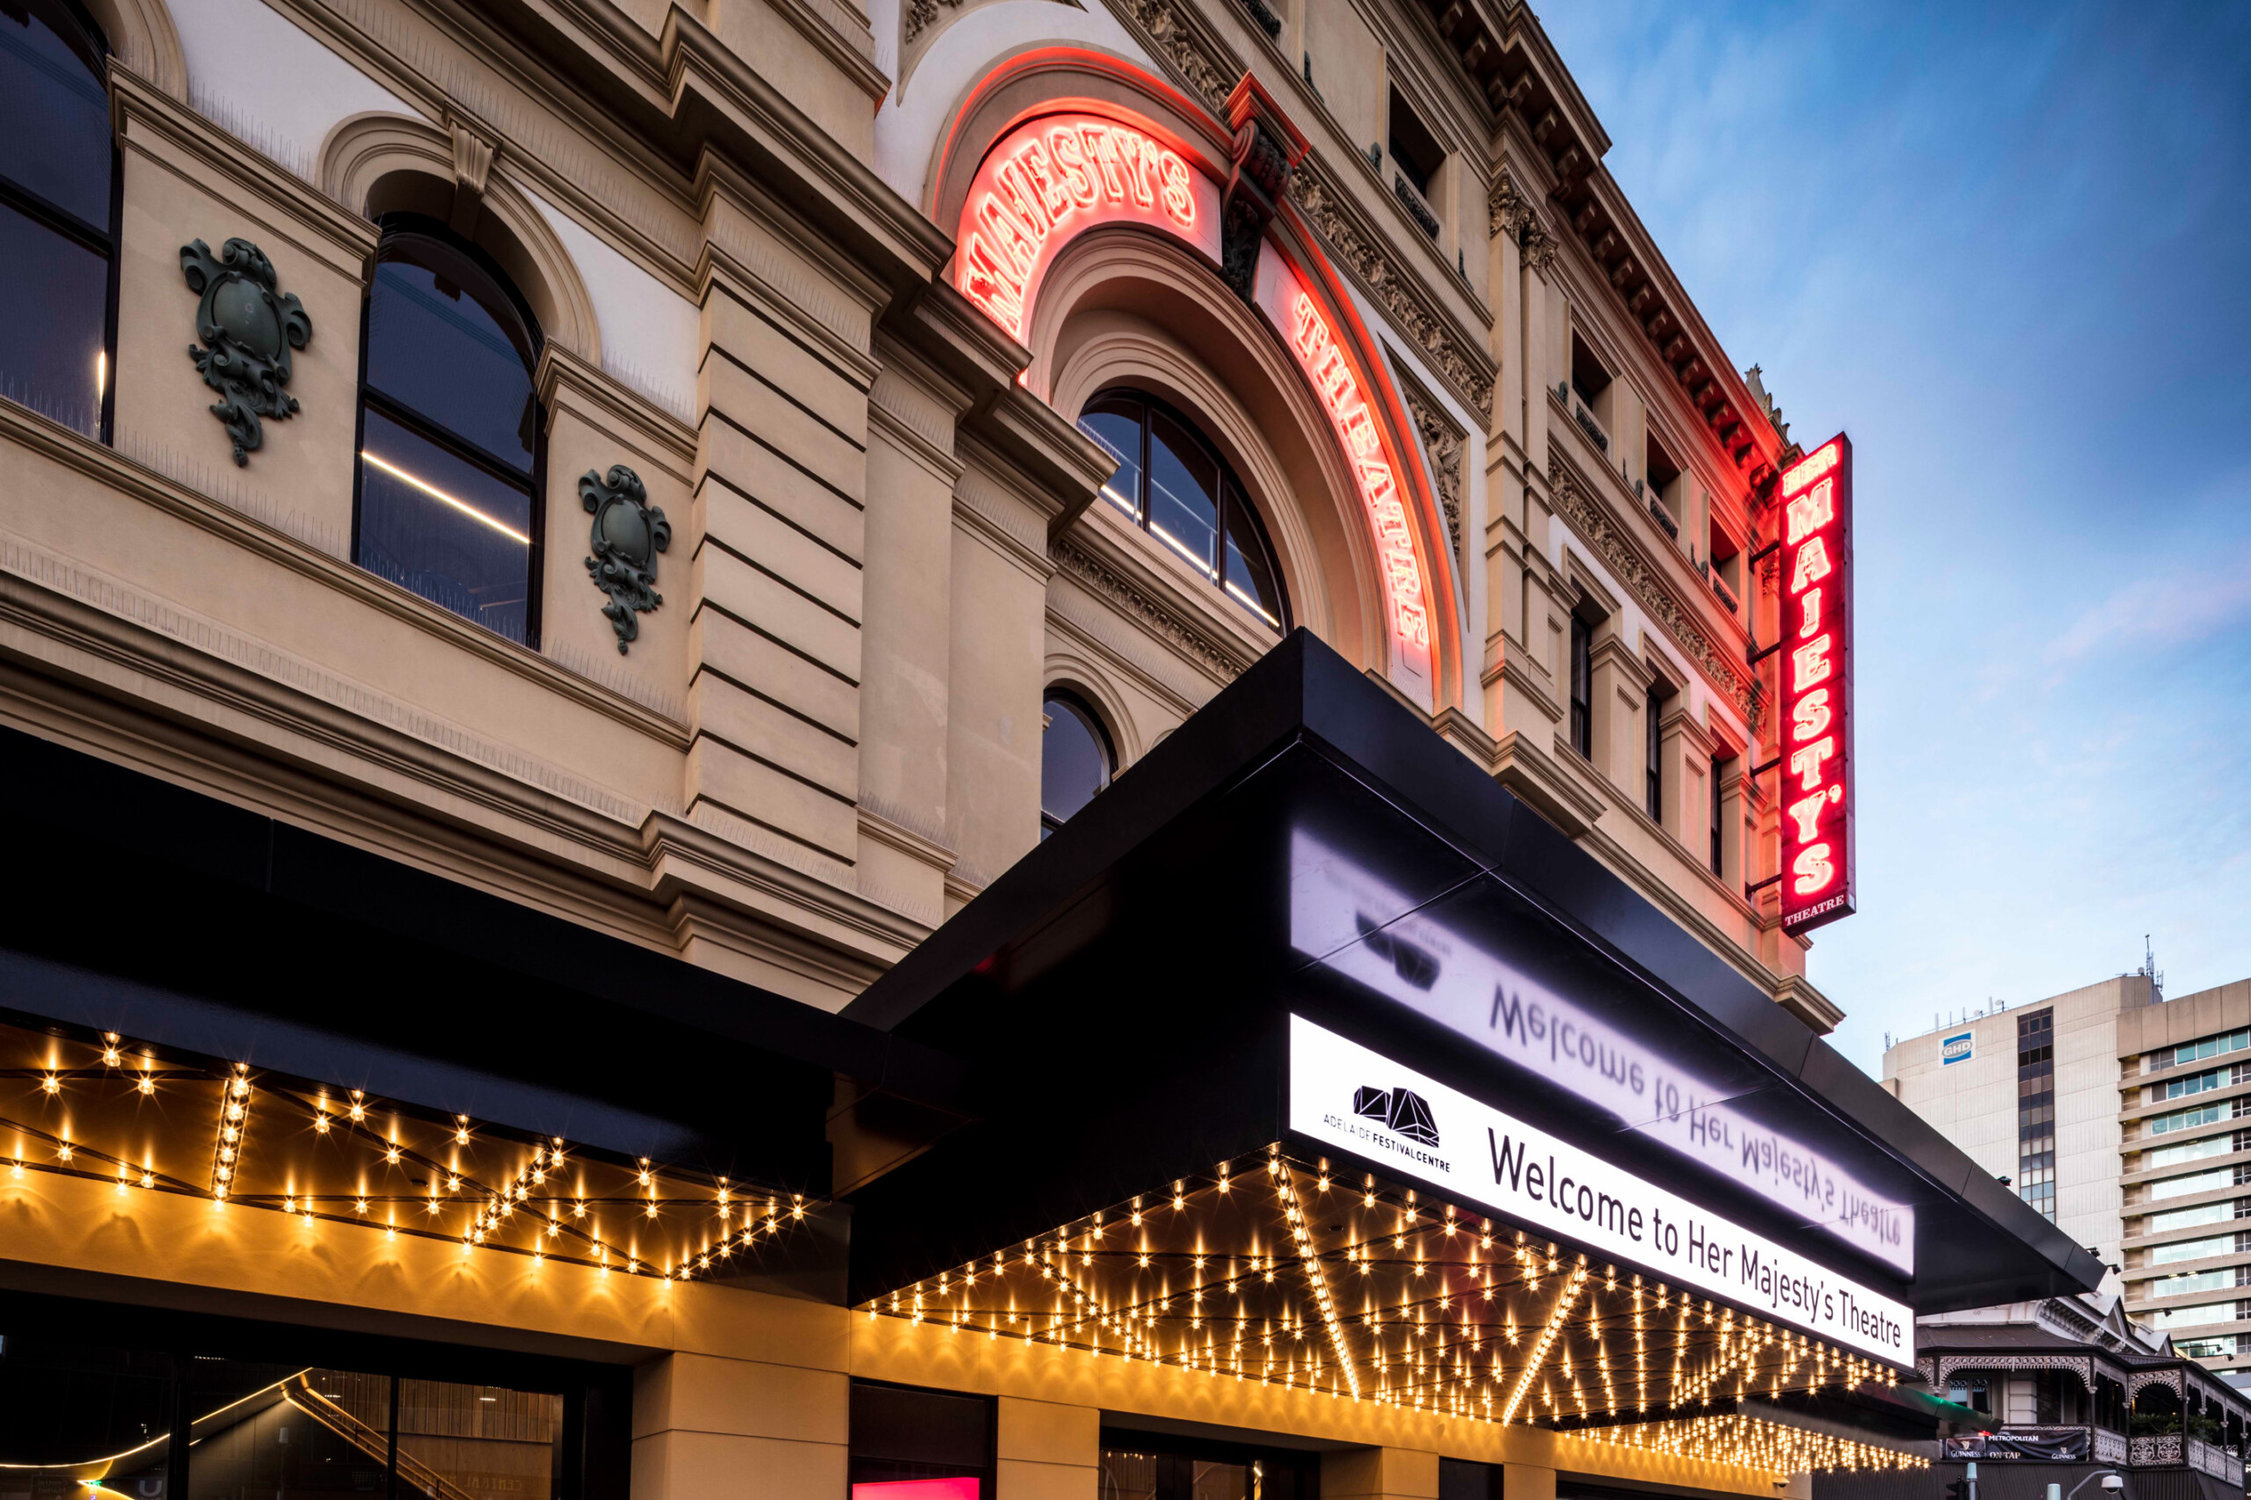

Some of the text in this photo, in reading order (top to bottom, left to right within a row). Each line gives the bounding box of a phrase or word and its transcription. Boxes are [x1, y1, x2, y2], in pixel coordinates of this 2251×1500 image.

[965, 122, 1197, 338] MAJESTY'S
[1293, 291, 1430, 649] THEATRE
[1782, 443, 1838, 498] HER
[1785, 477, 1843, 896] MAJESTY'S
[1784, 894, 1845, 927] THEATRE
[1943, 1041, 1971, 1056] GHD
[1487, 1126, 1901, 1348] Welcome to Her Majesty's Theatre
[1988, 1434, 2039, 1442] METROPOLITAN
[2005, 1451, 2021, 1459] TAP
